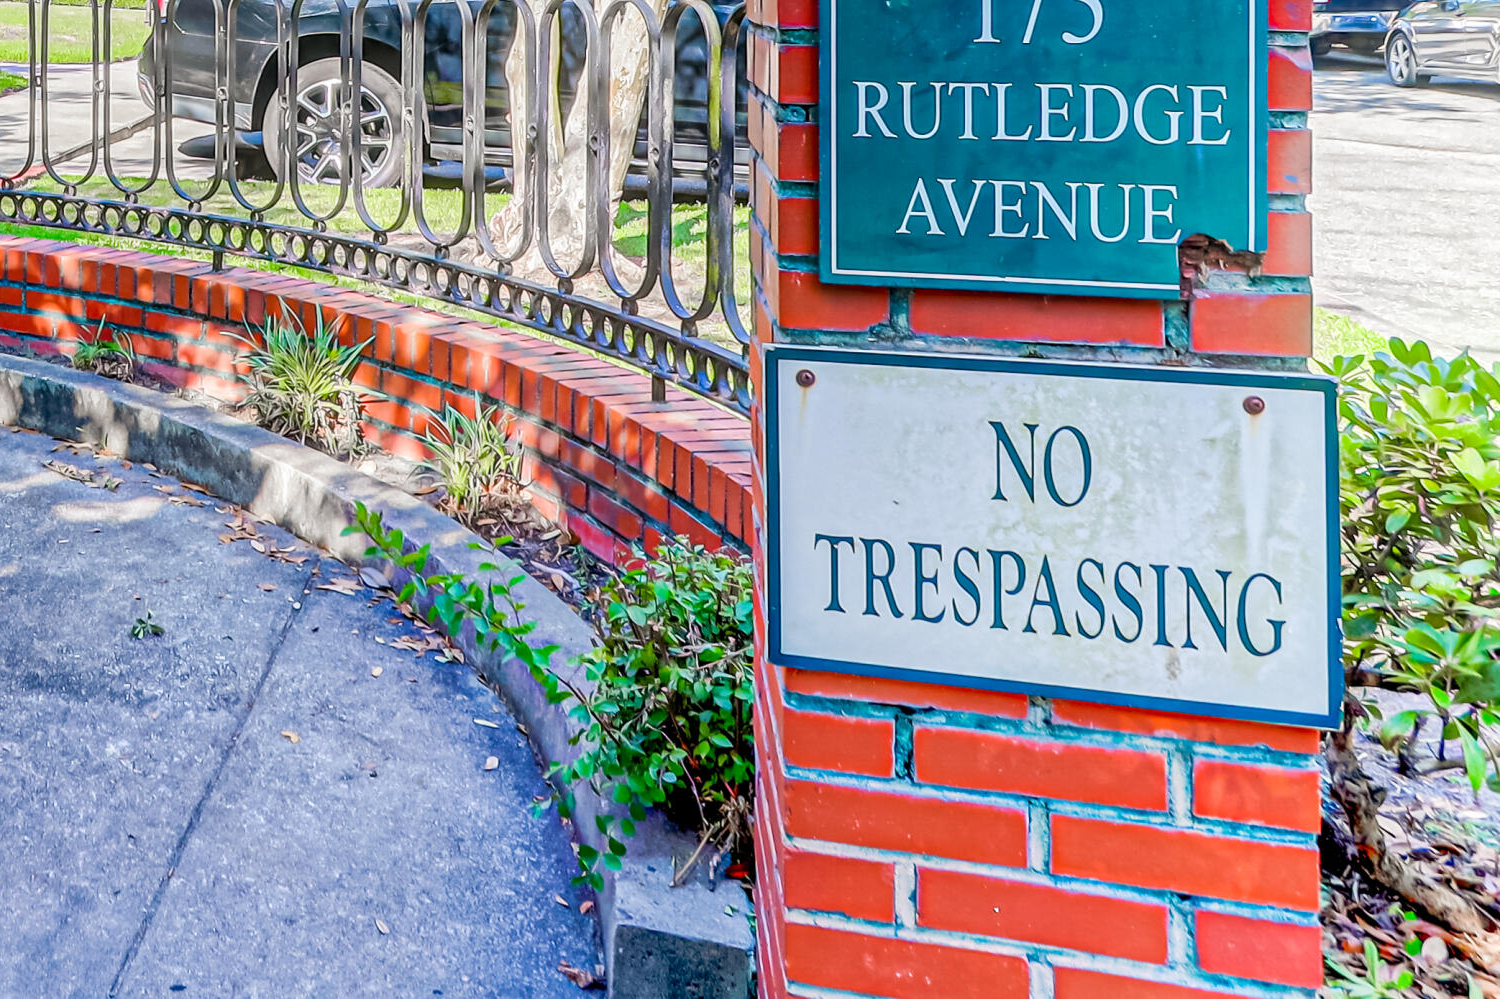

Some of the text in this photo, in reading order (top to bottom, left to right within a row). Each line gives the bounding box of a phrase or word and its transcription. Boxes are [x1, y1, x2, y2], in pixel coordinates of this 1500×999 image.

[852, 80, 1232, 147] RUTLEDGE
[896, 177, 1182, 246] AVENUE
[988, 420, 1093, 508] NO
[814, 534, 1287, 656] TRESPASSING
